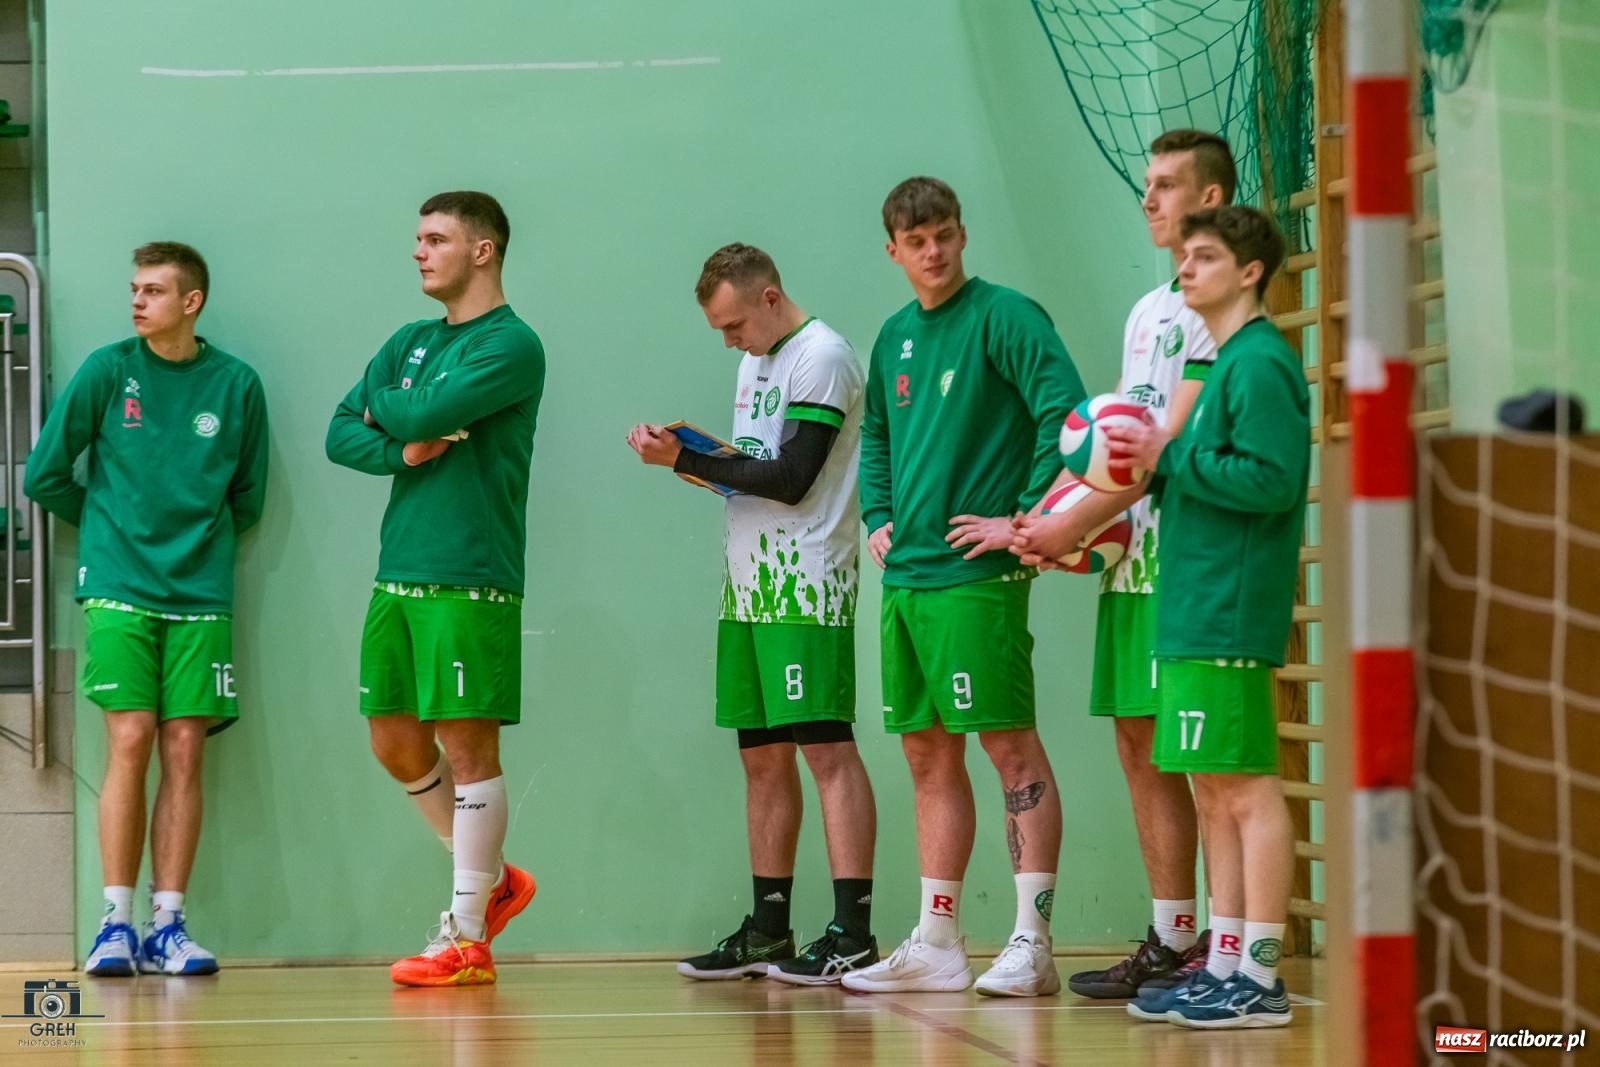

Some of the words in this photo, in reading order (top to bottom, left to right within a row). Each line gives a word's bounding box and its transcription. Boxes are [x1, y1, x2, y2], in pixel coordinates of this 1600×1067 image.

[896, 374, 911, 398] R
[124, 398, 142, 420] R
[453, 661, 464, 698] 1
[785, 664, 803, 700] 8
[952, 672, 972, 710] 9
[1178, 710, 1206, 751] 17
[933, 894, 953, 912] R
[1174, 914, 1194, 929] R
[1220, 934, 1240, 951] R
